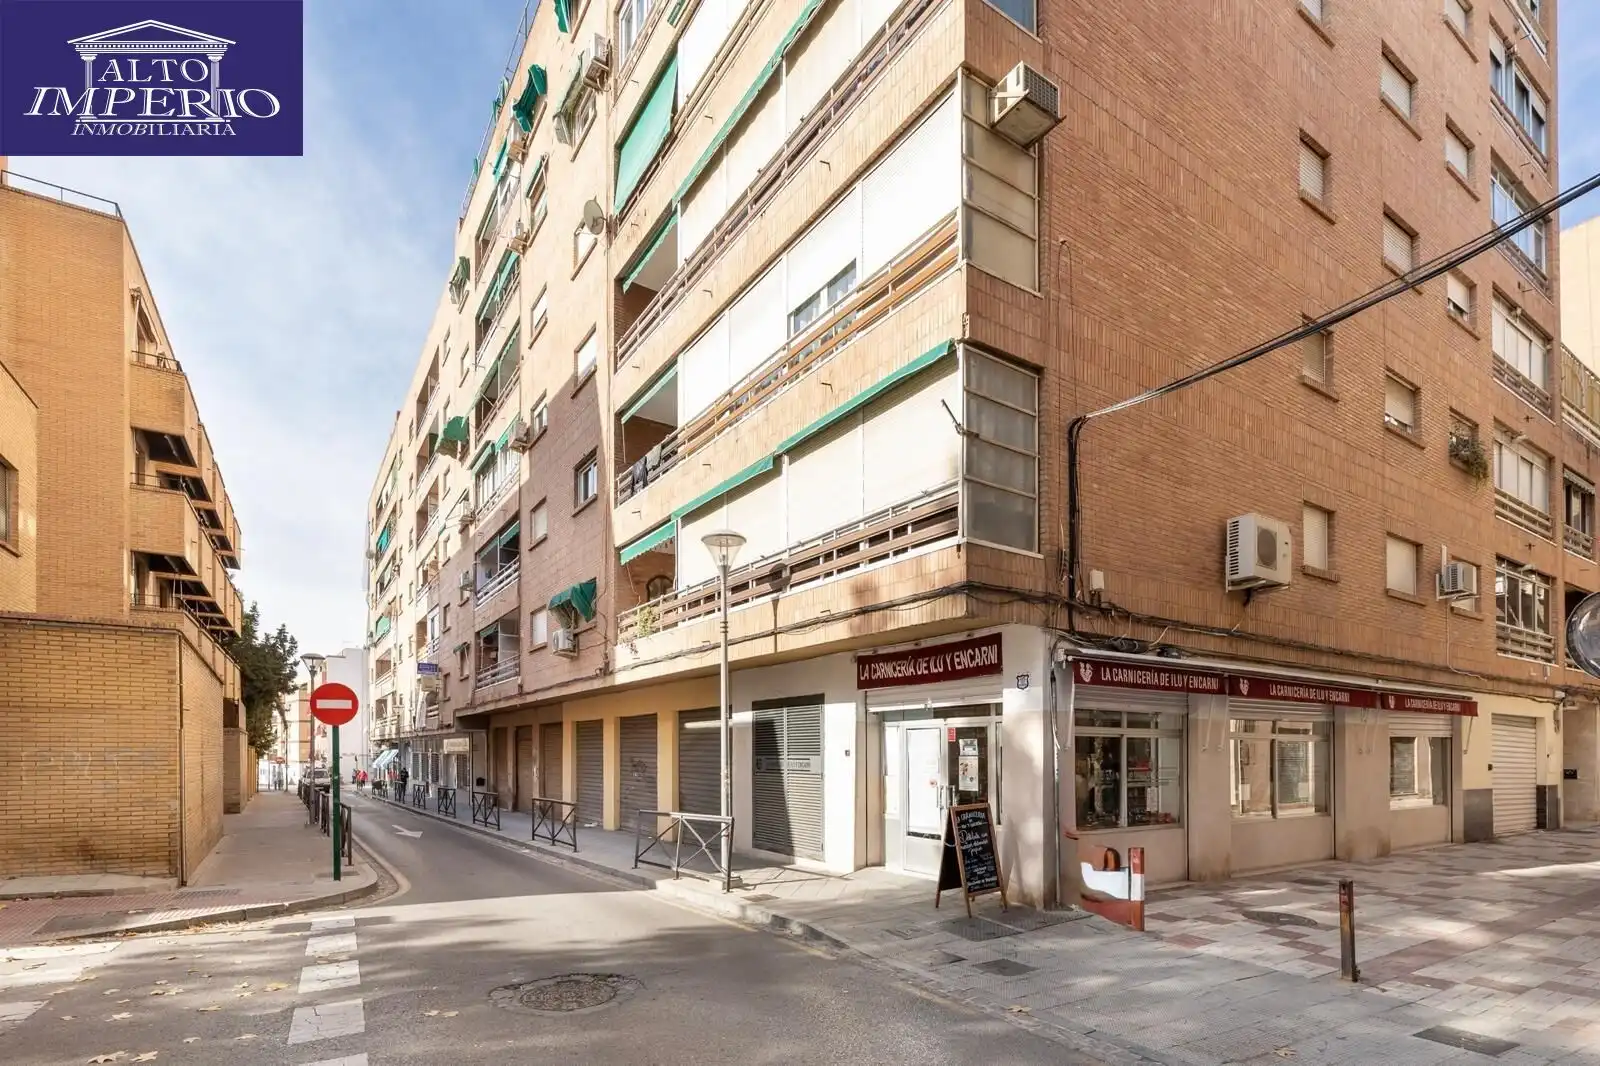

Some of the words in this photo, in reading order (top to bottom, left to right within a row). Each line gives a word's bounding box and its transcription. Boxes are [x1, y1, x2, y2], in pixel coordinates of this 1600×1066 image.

[860, 663, 869, 680] LA
[871, 656, 916, 680] CARNICERÍA
[916, 658, 929, 675] DE
[946, 652, 953, 671] Y
[953, 644, 998, 670] ENCARNI
[1101, 666, 1111, 681] LA
[1112, 668, 1159, 685] CARNICERÍA
[1160, 674, 1170, 687] DE
[1182, 675, 1188, 688] Y
[1189, 675, 1219, 690] ENCARNI
[1269, 683, 1277, 696] LA
[1277, 685, 1309, 698] CARNICERÍA
[1309, 688, 1317, 700] DE
[1329, 690, 1350, 702] ENCARNI
